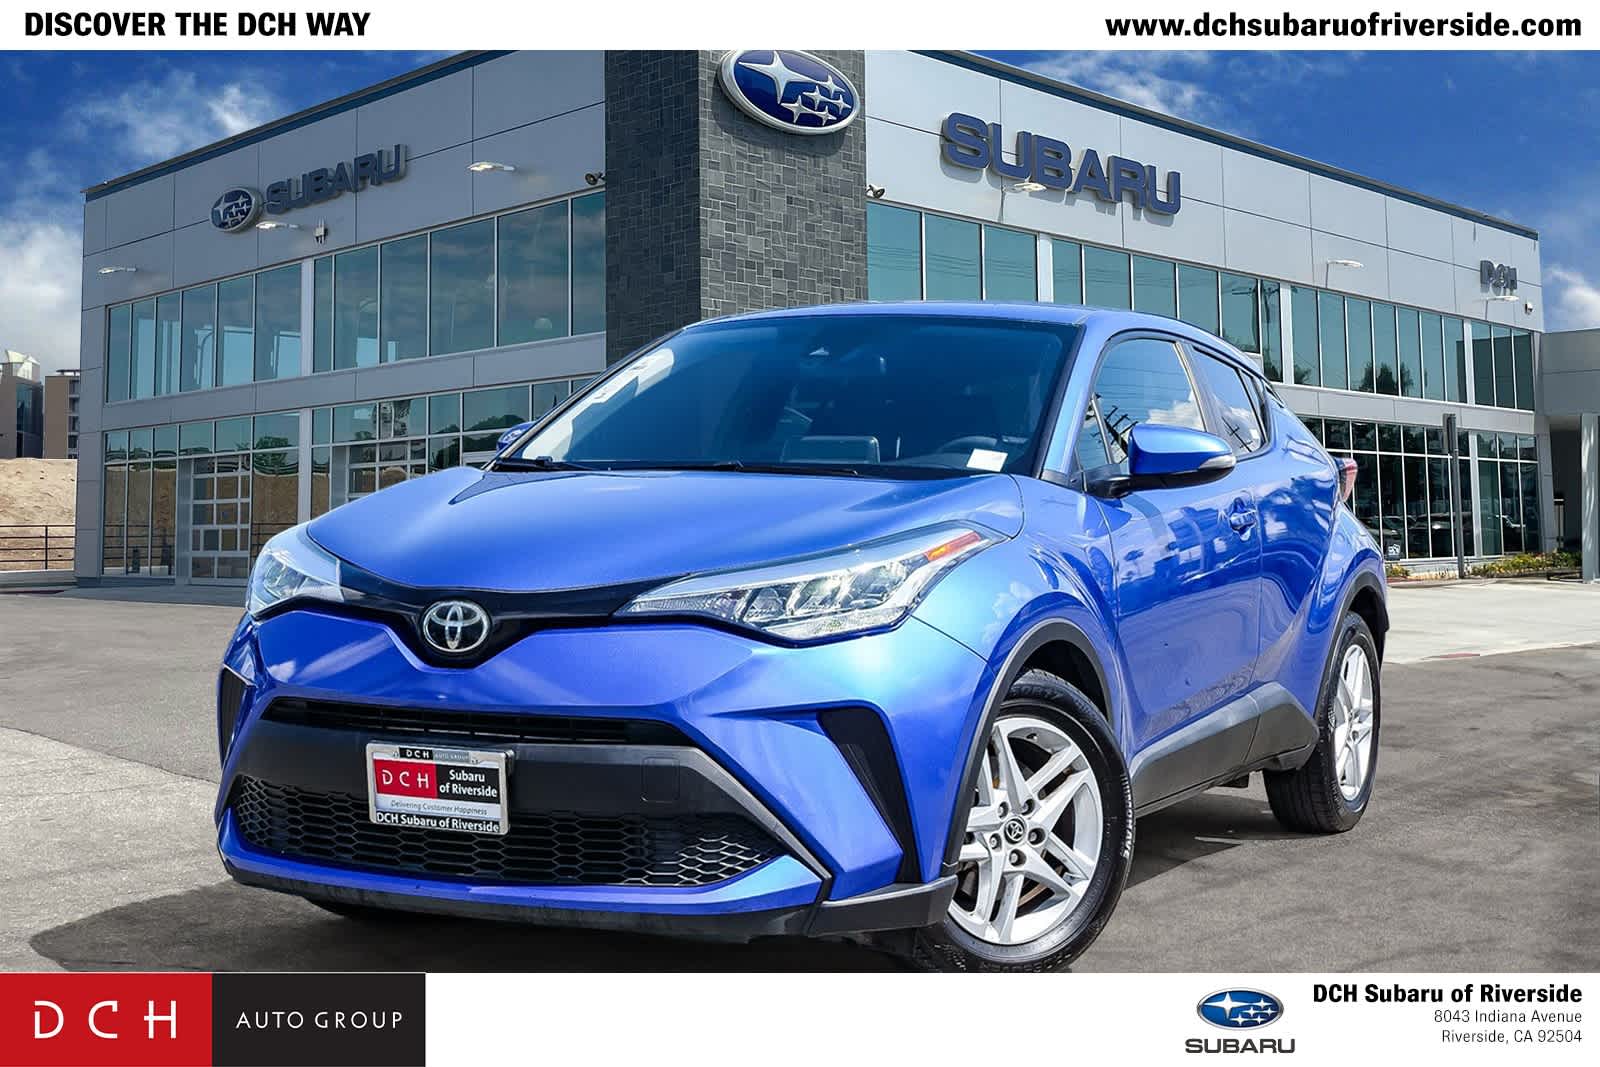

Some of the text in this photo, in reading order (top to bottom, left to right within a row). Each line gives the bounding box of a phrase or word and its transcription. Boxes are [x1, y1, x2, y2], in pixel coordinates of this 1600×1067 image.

[942, 112, 1181, 215] SUBARU
[266, 144, 407, 215] SUBARU
[405, 749, 430, 759] DCH
[382, 769, 429, 789] DCH
[449, 769, 486, 782] Subaru
[439, 782, 498, 798] of Riverside
[376, 812, 500, 833] DCH Subaru of Riverside
